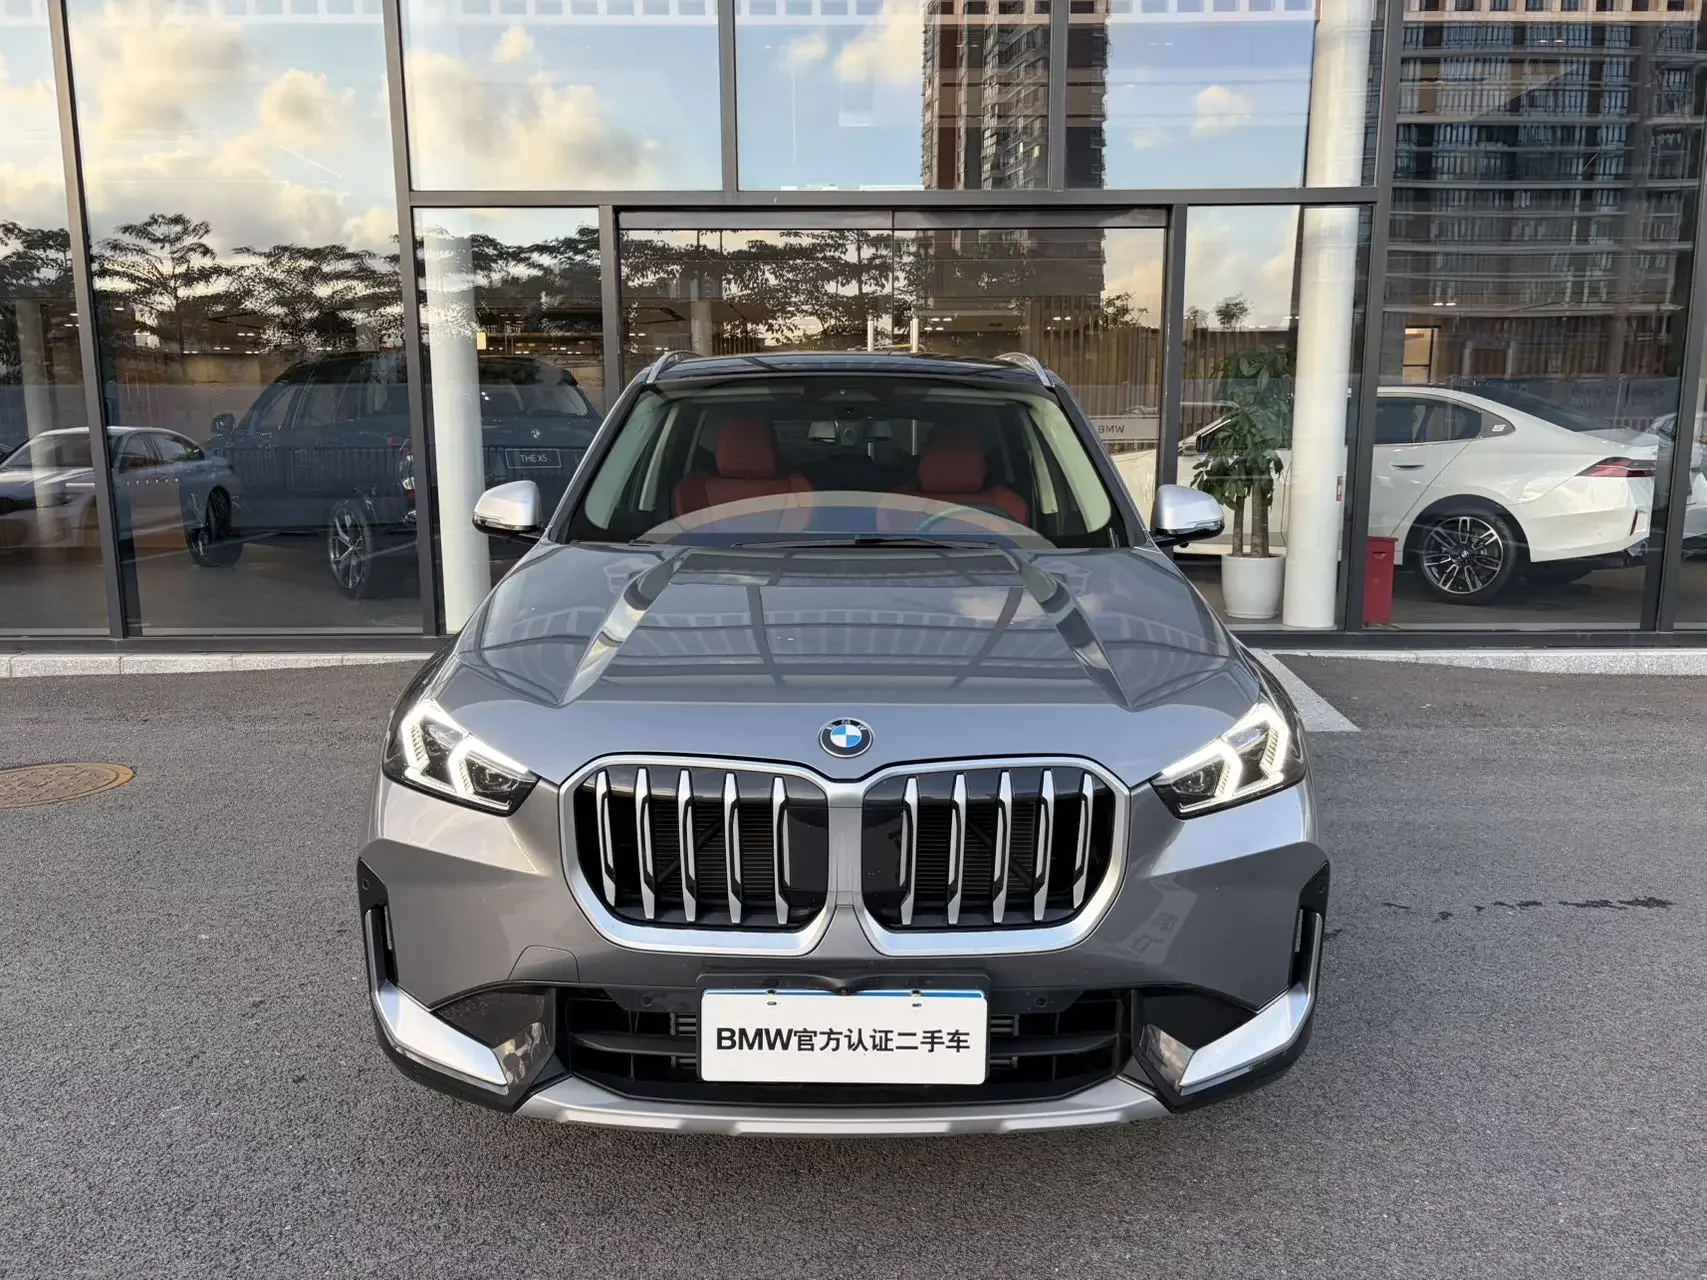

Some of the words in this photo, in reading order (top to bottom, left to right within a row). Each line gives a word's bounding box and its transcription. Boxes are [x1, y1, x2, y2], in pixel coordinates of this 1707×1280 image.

[1099, 424, 1125, 434] BMW
[520, 454, 537, 463] THE
[537, 453, 548, 463] X5
[716, 1027, 971, 1053] BMW官方认证二手车
